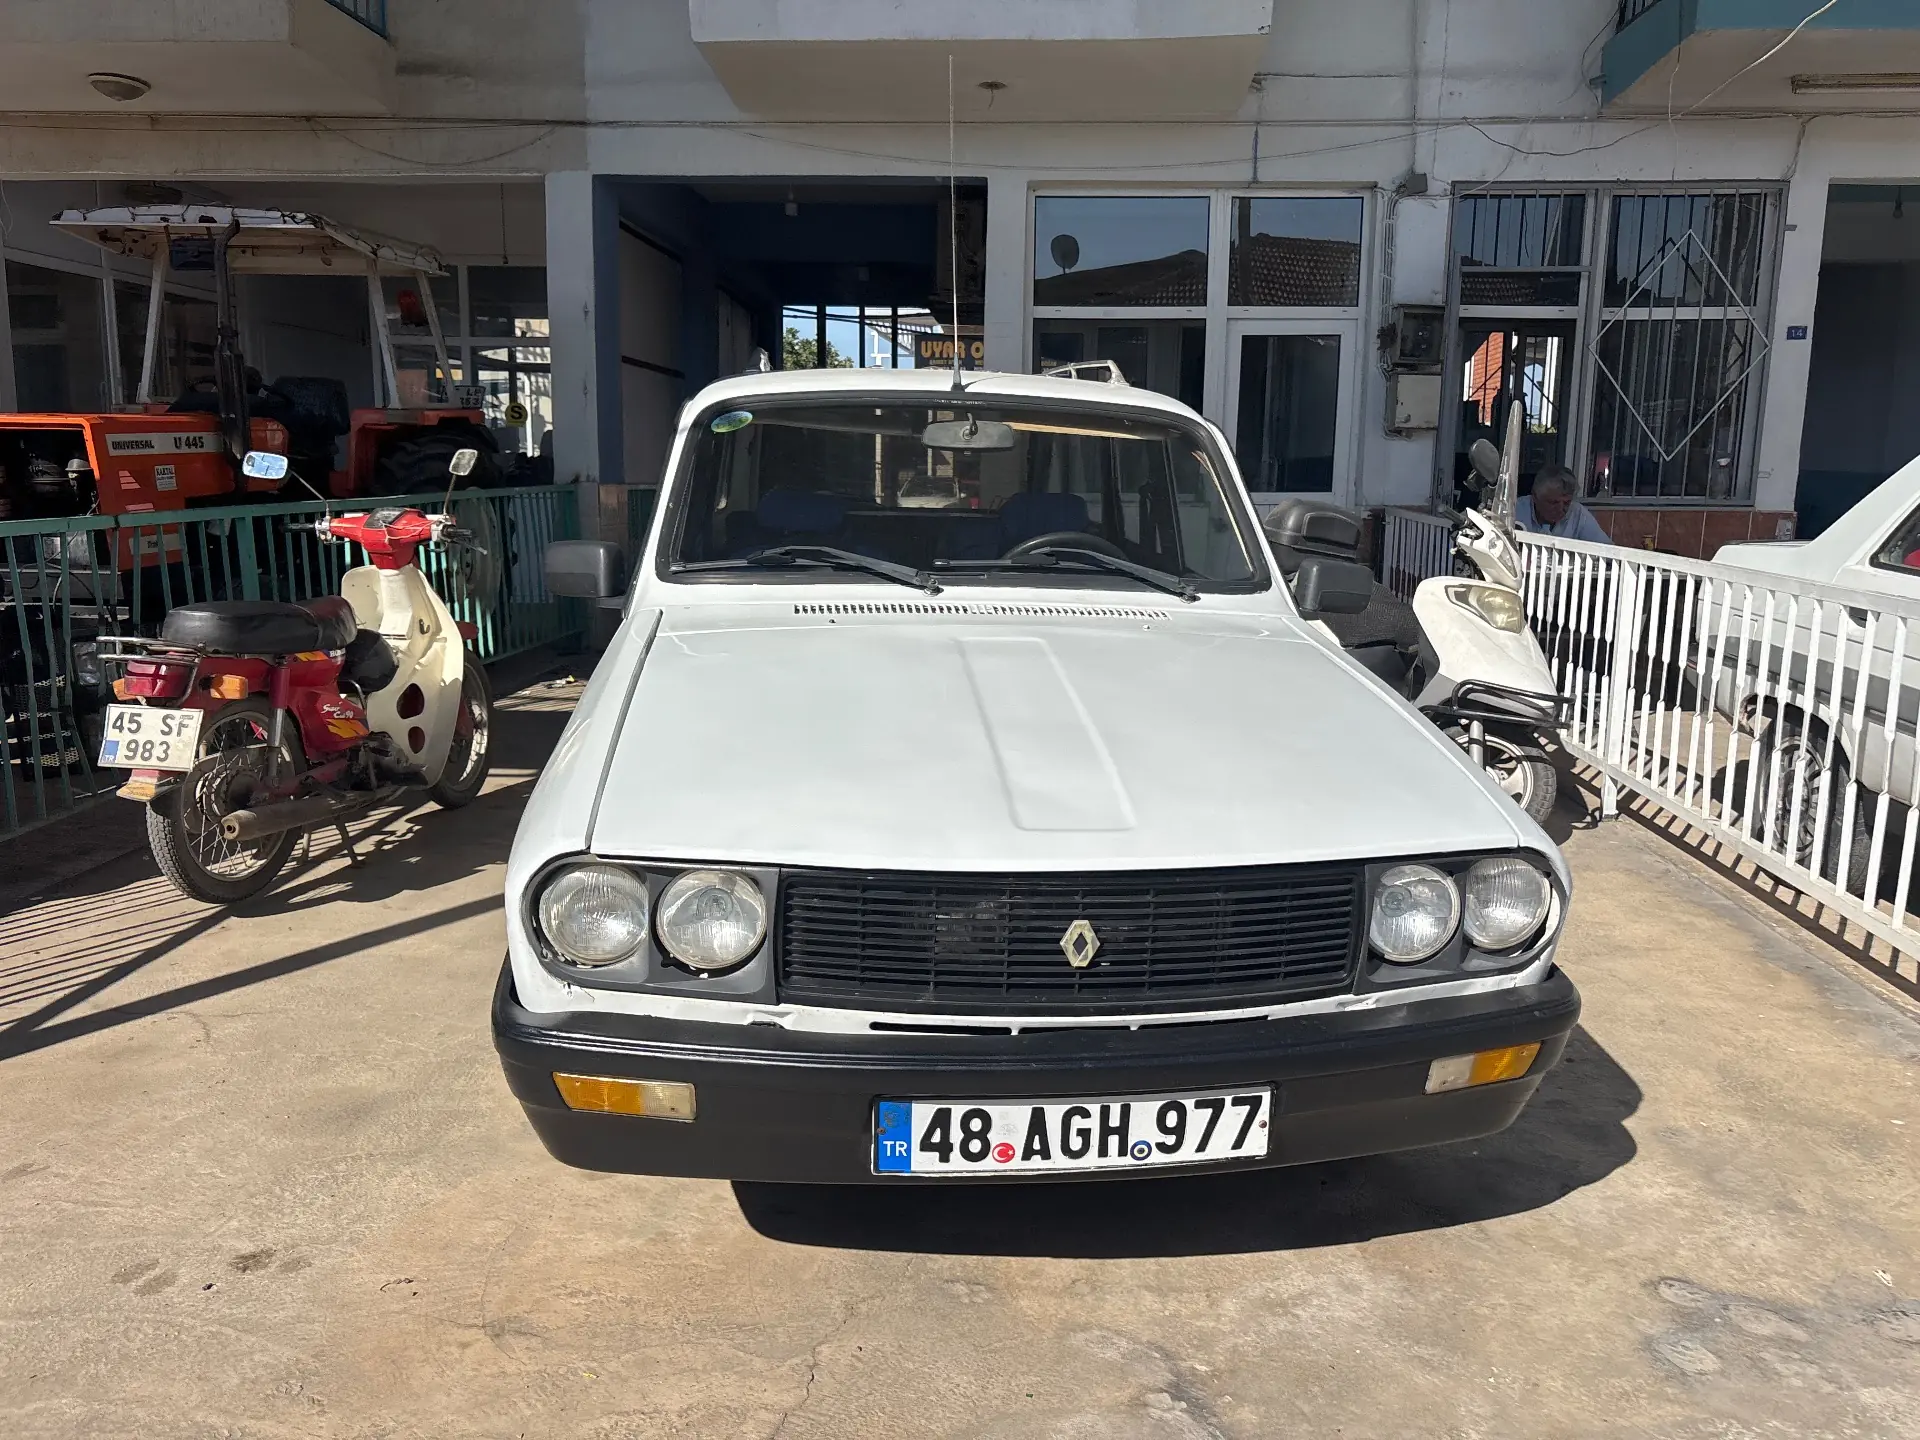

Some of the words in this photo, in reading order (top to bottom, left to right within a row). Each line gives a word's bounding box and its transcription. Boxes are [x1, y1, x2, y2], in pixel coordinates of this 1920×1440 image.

[1791, 329, 1803, 338] 14
[921, 341, 966, 359] UYAR
[510, 405, 523, 420] S
[112, 440, 155, 450] UNIVERSAL
[173, 436, 182, 449] U
[185, 436, 205, 449] 445
[112, 711, 142, 734] 45
[160, 713, 194, 737] SF
[124, 739, 170, 762] 983
[883, 1140, 908, 1157] TR
[919, 1107, 992, 1164] 48
[1020, 1103, 1131, 1161] AGH
[1154, 1095, 1264, 1156] 977
